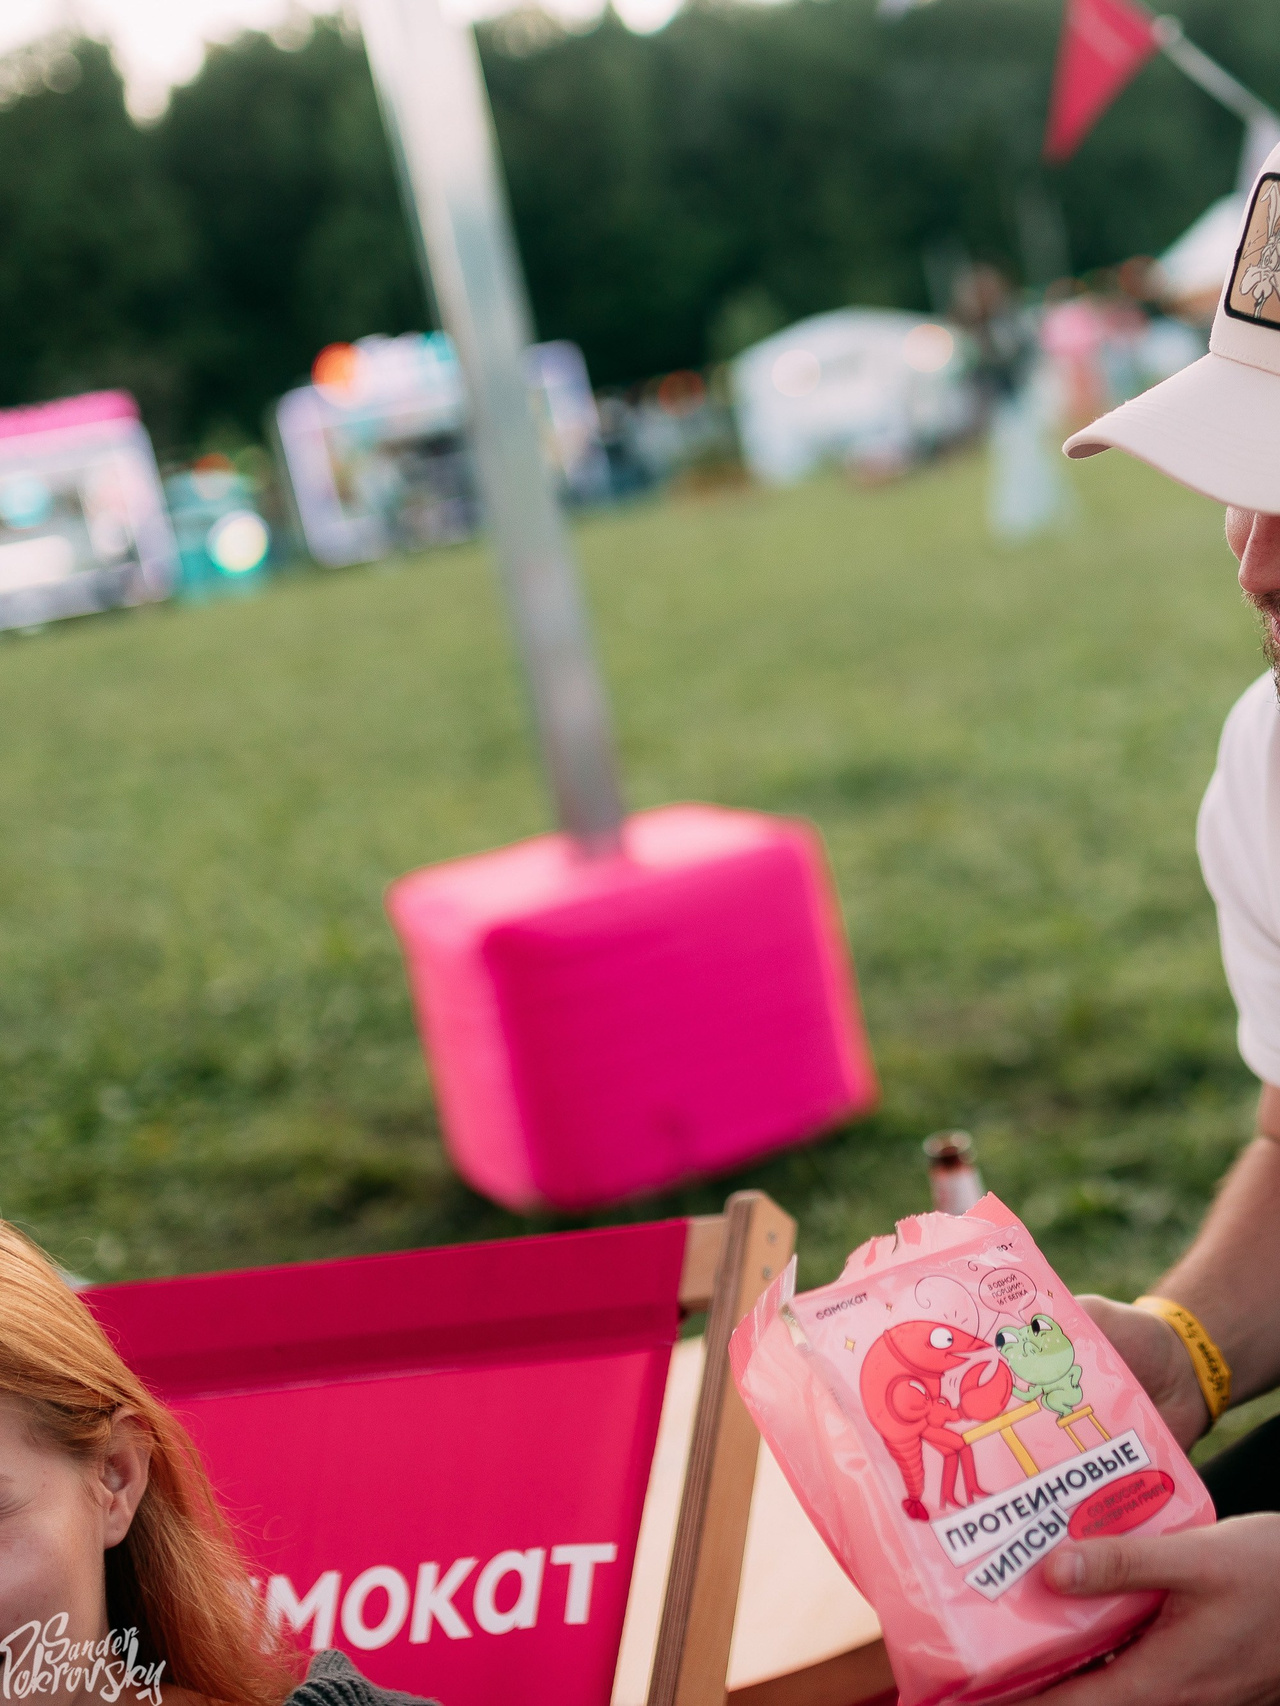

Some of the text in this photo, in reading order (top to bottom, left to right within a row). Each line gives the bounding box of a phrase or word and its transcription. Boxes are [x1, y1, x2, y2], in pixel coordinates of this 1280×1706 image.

[993, 1273, 1018, 1288] ОДНОЙ
[945, 1441, 1139, 1551] ПРОТЕИНОВЫЕ
[974, 1509, 1067, 1588] ЧИПСЫ
